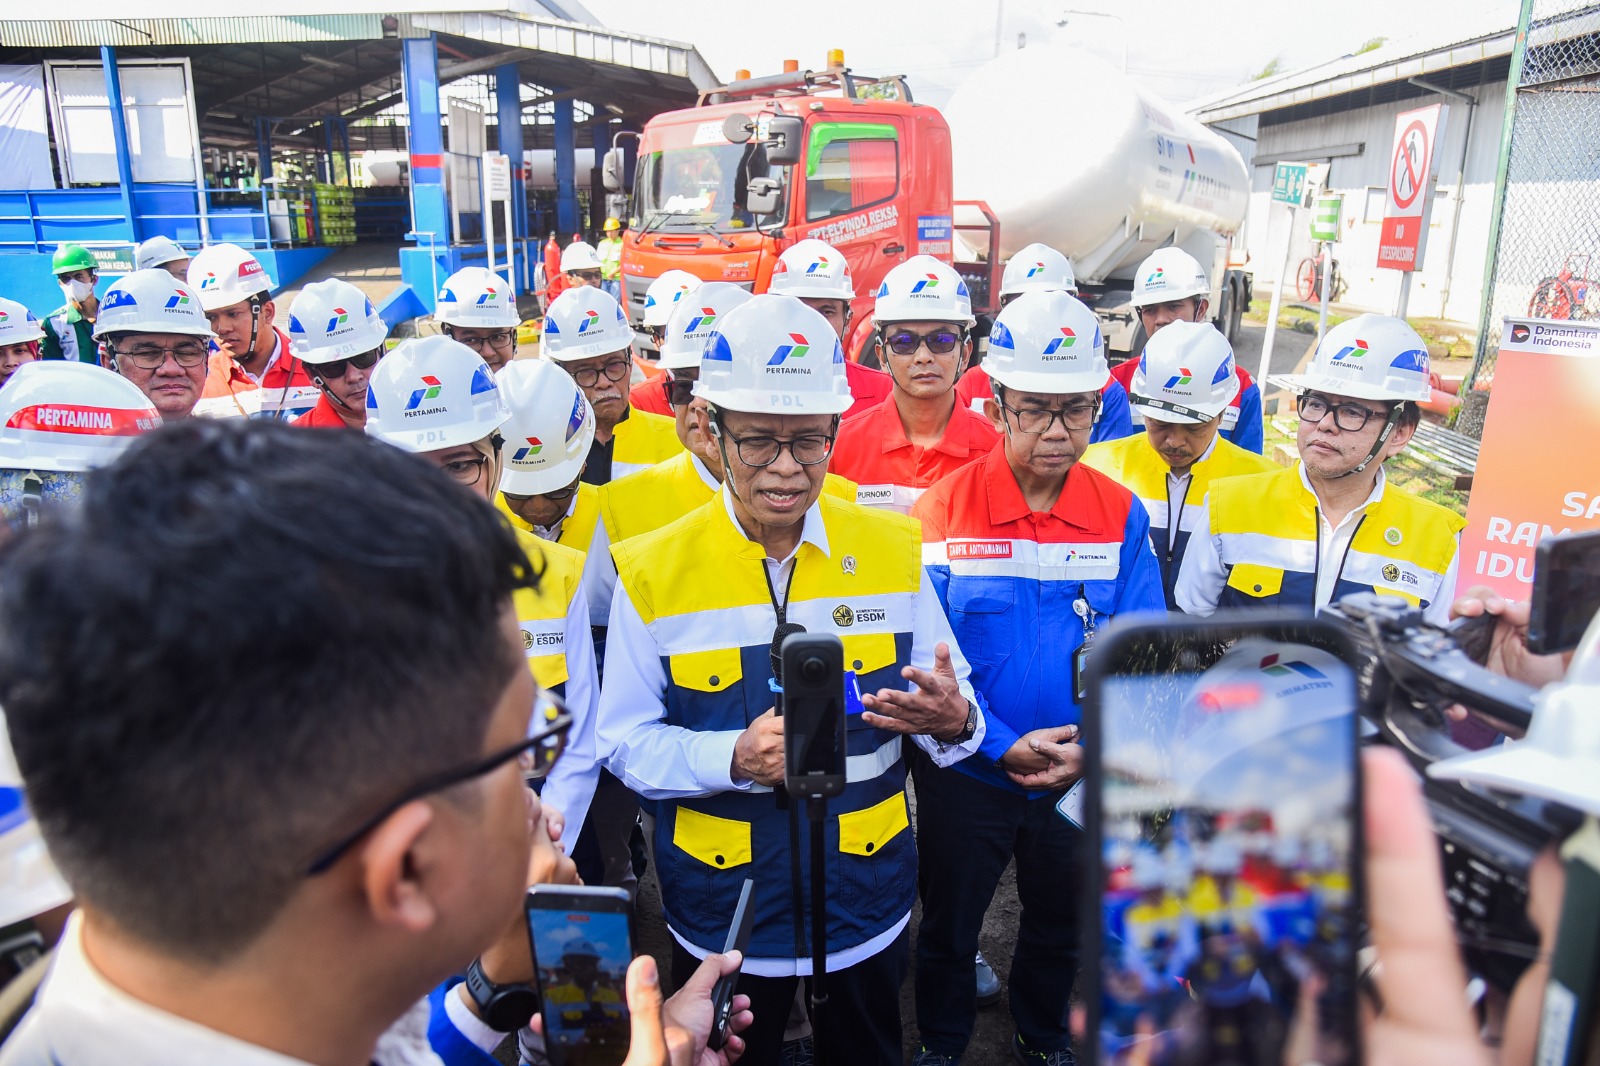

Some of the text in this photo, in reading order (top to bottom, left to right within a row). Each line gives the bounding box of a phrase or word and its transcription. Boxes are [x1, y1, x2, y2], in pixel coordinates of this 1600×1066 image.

[868, 204, 899, 225] REKSA
[1395, 224, 1404, 239] NO
[163, 308, 194, 318] PERTAMINA
[326, 326, 355, 339] PERTAMINA
[578, 328, 605, 340] PERTAMINA
[683, 332, 710, 340] PERTAMI
[1534, 325, 1599, 340] Danantara
[1532, 335, 1592, 350] Indonesia
[1041, 354, 1078, 362] PERTAMINA
[765, 366, 813, 376] PERTAMINA
[1329, 360, 1365, 372] PERTAMINA
[1162, 387, 1193, 398] PERTAMINA
[770, 394, 804, 408] PDL
[404, 405, 448, 419] PERTAMINA
[36, 407, 114, 431] PERTAMINA
[416, 430, 447, 445] PDL
[511, 458, 547, 466] PERTAMINA
[857, 490, 892, 499] PURNOMO
[949, 545, 967, 556] TAUFIK
[1402, 574, 1418, 586] ESDM
[857, 613, 886, 623] ESDM
[536, 636, 564, 646] ESDM
